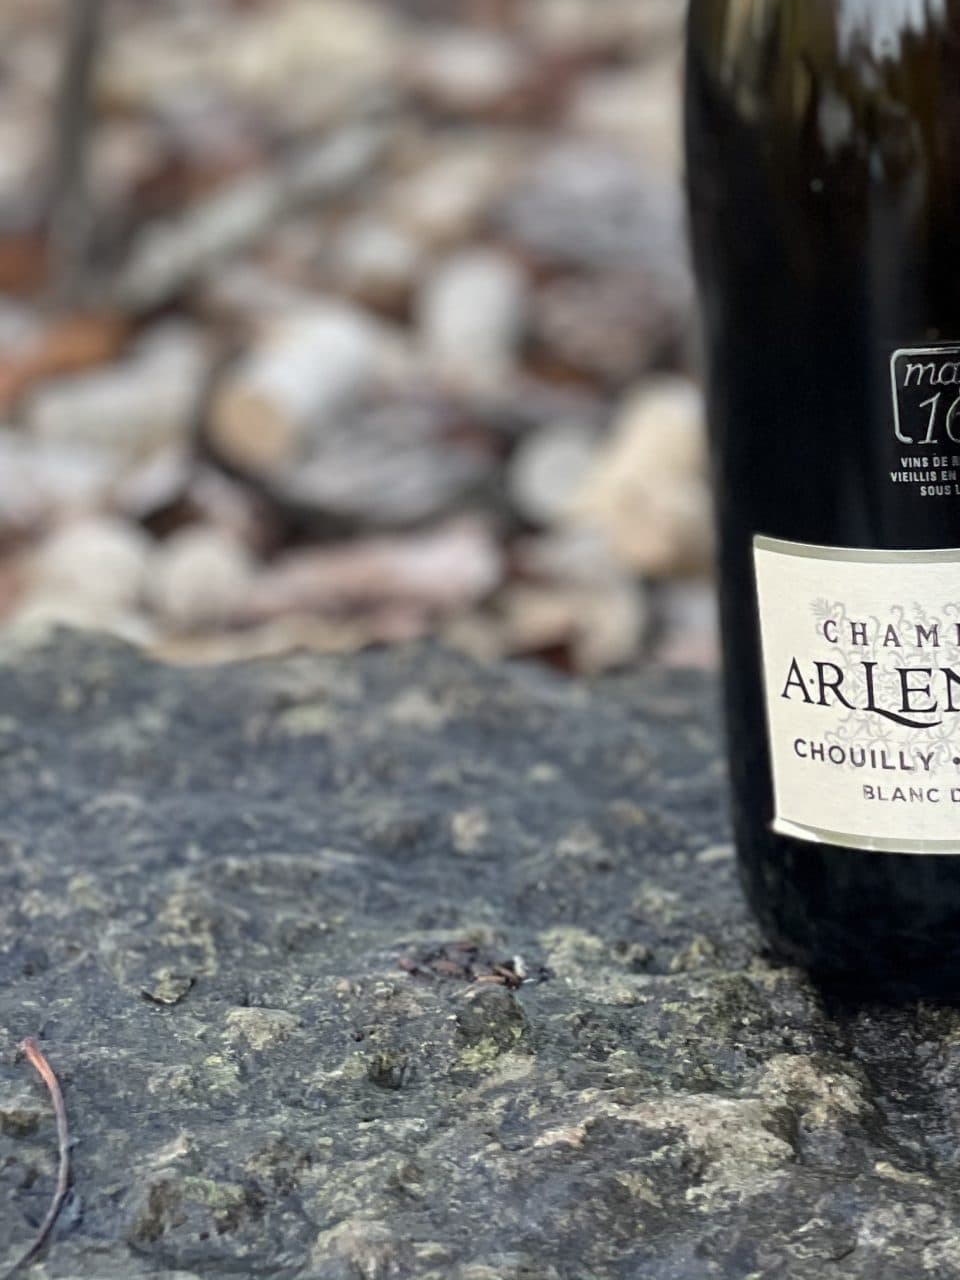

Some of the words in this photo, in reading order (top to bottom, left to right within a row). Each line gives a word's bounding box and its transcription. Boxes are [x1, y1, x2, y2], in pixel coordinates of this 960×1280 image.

[901, 456, 929, 468] VINS
[933, 456, 948, 467] DE
[890, 471, 937, 482] VIEILLIS
[941, 470, 957, 481] EN
[920, 485, 951, 496] SOUS
[794, 738, 936, 772] CHOUILLY
[862, 783, 940, 804] BLANC
